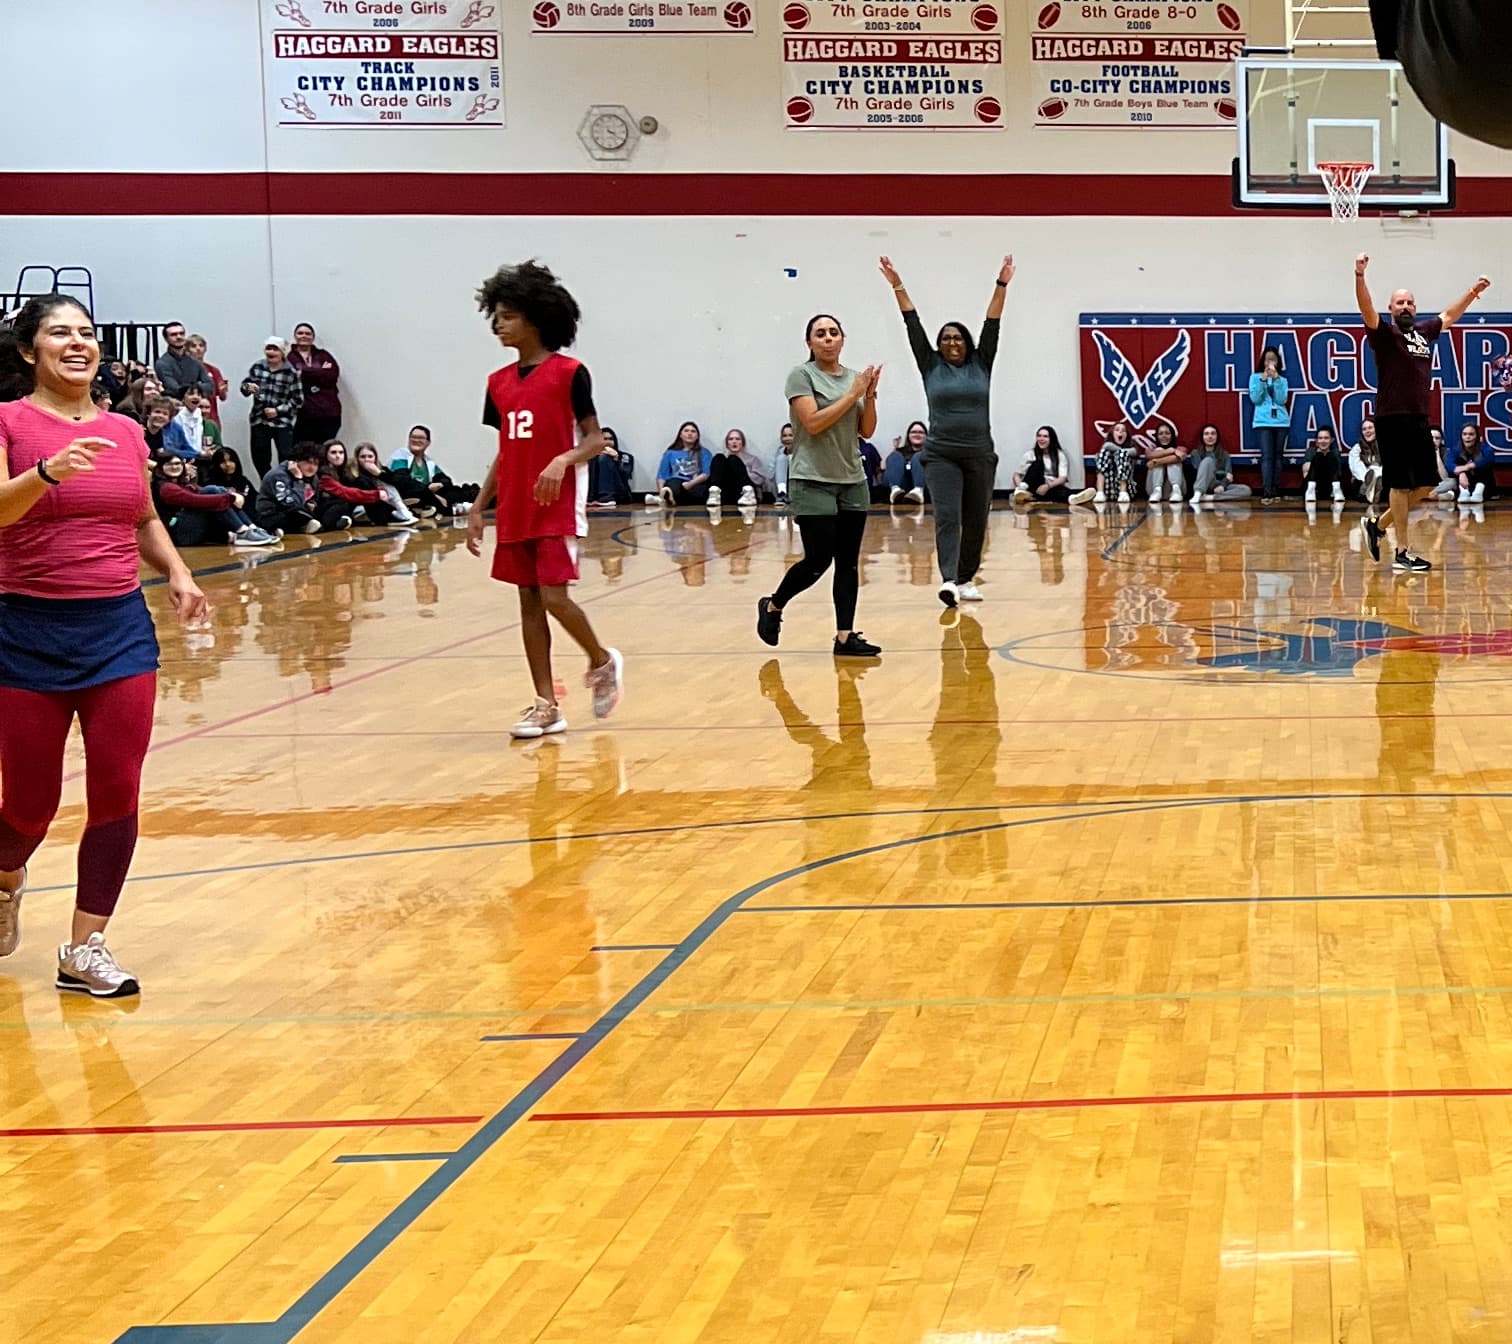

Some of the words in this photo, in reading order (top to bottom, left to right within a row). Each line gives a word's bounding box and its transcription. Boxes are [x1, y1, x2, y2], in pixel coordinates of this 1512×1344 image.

[323, 1, 347, 13] 7th
[356, 1, 403, 14] Grade
[411, 1, 446, 14] Girls
[567, 3, 585, 16] 8th
[591, 3, 623, 16] Grade
[629, 3, 653, 16] Girls
[659, 3, 682, 16] Blue
[687, 3, 717, 16] Team
[831, 4, 855, 17] 7th
[863, 4, 909, 17] Grade
[917, 5, 951, 17] Girls
[1082, 5, 1107, 18] 8th
[1115, 6, 1159, 18] Grade
[1168, 6, 1196, 19] 8-0
[373, 18, 398, 27] 2006
[629, 19, 654, 27] 2009
[865, 22, 921, 30] 2003-2004
[1127, 21, 1151, 30] 2006
[278, 36, 390, 58] HAGGARD
[402, 36, 497, 58] EAGLES
[787, 41, 897, 62] HAGGARD
[908, 41, 999, 62] EAGLES
[1035, 39, 1144, 60] HAGGARD
[1154, 39, 1242, 60] EAGLES
[361, 62, 415, 74] TRACK
[839, 65, 949, 77] BASKETBALL
[1102, 65, 1178, 77] FOOTBALL
[298, 76, 344, 90] CITY
[357, 77, 479, 91] CHAMPIONS
[806, 80, 852, 94] CITY
[864, 80, 983, 94] CHAMPIONS
[1051, 80, 1121, 93] CO-CITY
[1130, 80, 1230, 93] CHAMPIONS
[328, 94, 352, 106] 7th
[361, 94, 408, 107] Grade
[416, 94, 452, 107] Girls
[835, 97, 858, 109] 7th
[866, 97, 912, 110] Grade
[920, 97, 954, 110] Girls
[1074, 98, 1089, 107] 7th
[1094, 99, 1123, 107] Grade
[1128, 99, 1152, 109] Boys
[1157, 99, 1178, 107] Blue
[1182, 99, 1208, 108] Team
[380, 111, 401, 119] 2011
[867, 114, 923, 122] 2005-2006
[1131, 113, 1152, 121] 2010
[507, 410, 534, 440] 12
